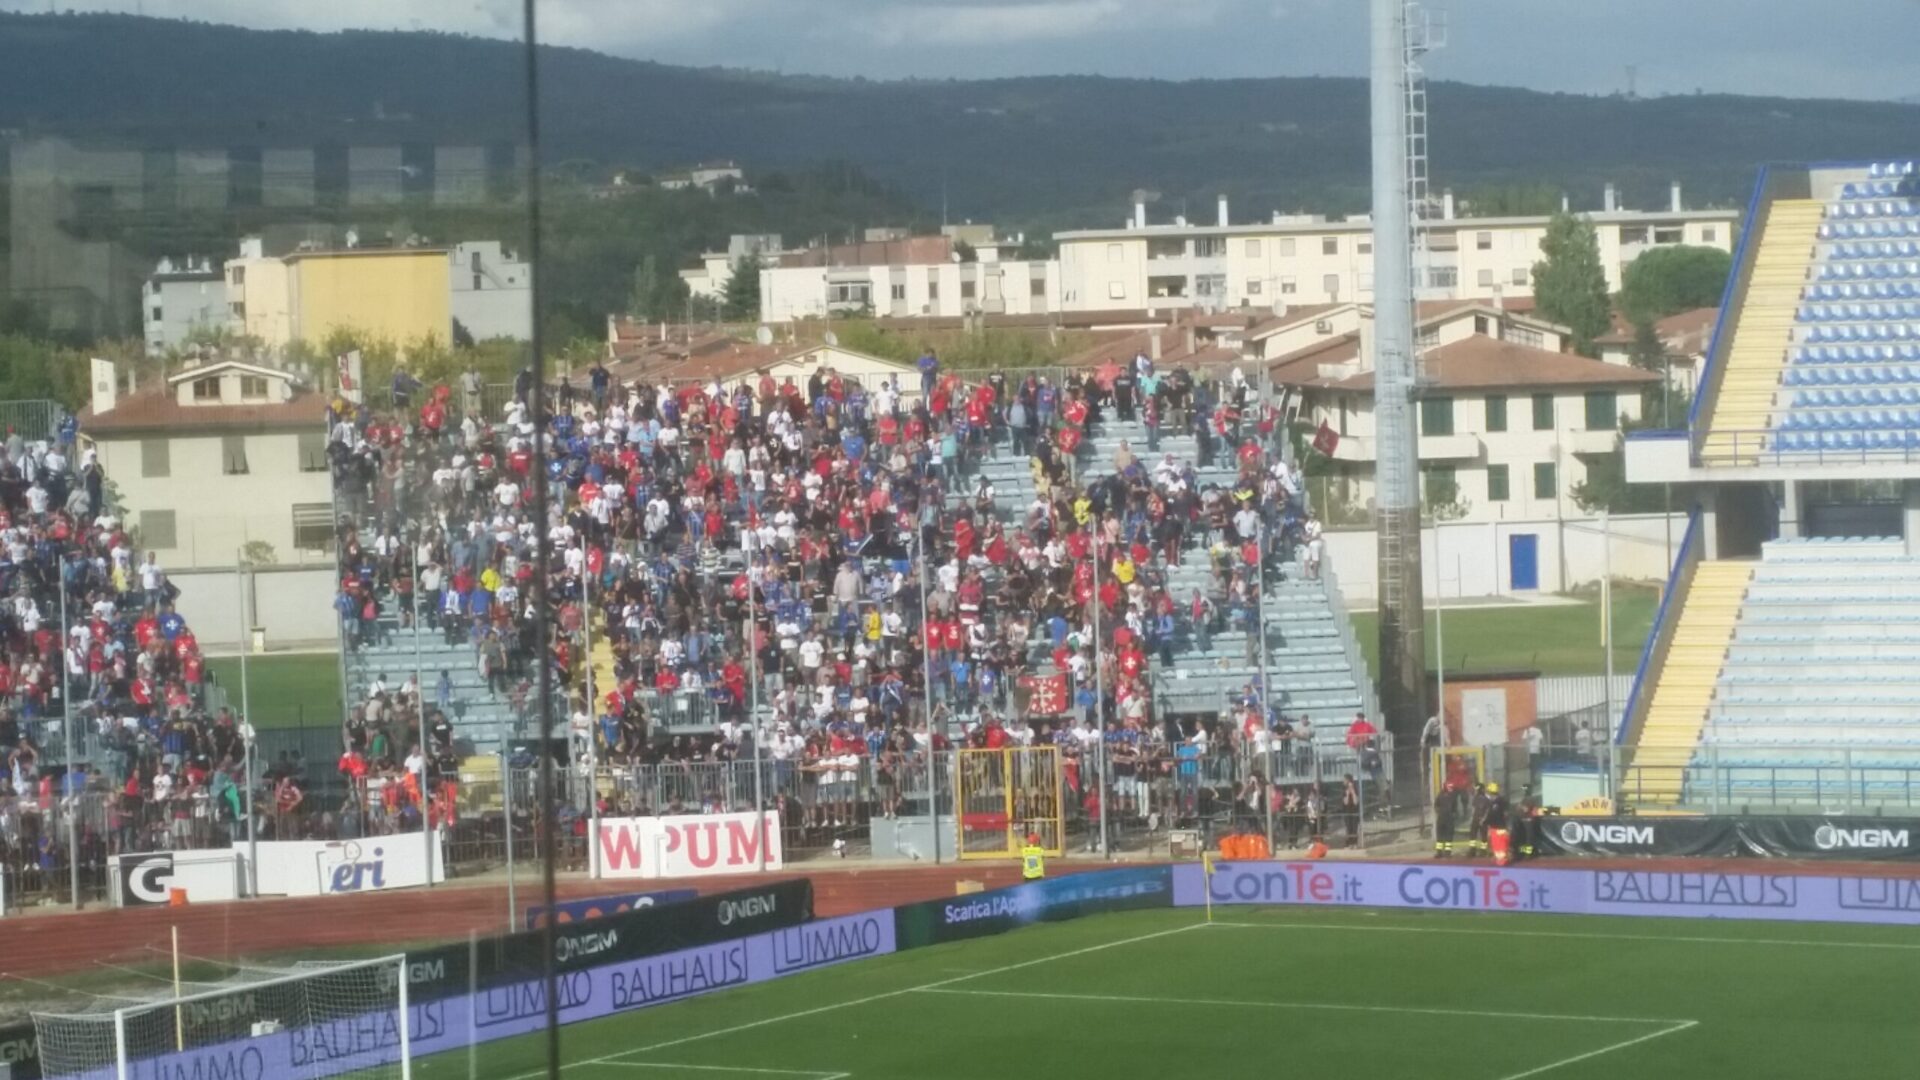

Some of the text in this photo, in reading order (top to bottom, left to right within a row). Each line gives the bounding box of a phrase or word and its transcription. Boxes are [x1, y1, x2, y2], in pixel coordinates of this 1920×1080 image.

[1209, 863, 1363, 902] ConTe.it
[1397, 867, 1551, 910] ConTe.it
[1595, 870, 1790, 906] BAUHAUS
[944, 900, 991, 924] Scarica
[612, 946, 744, 1010] BAUHAUS
